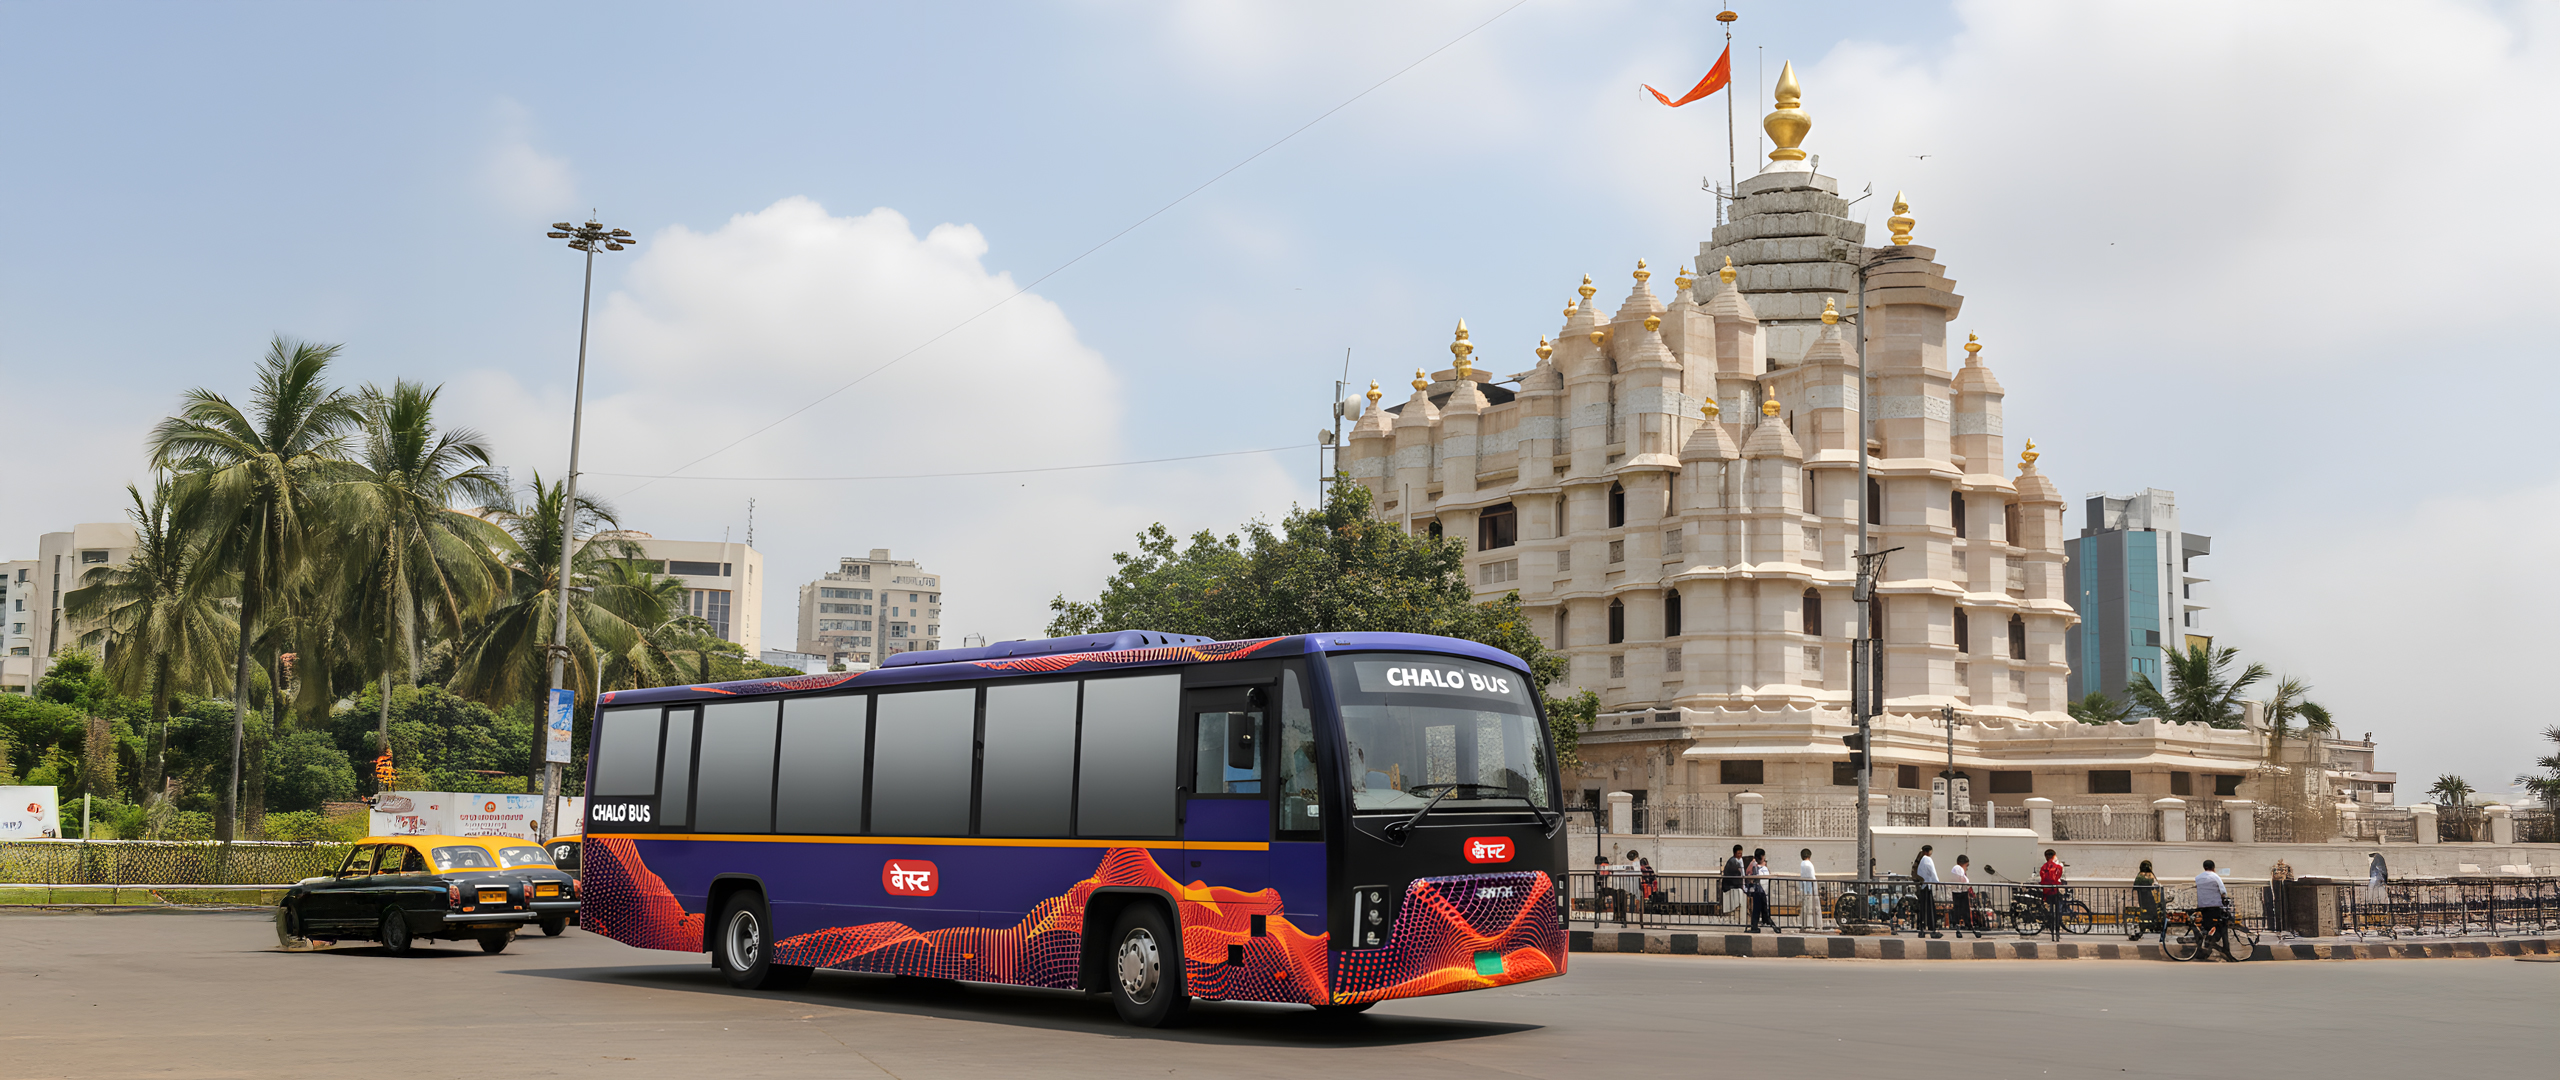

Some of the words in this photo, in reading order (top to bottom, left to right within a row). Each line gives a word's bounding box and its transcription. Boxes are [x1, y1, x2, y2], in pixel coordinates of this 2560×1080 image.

[1468, 672, 1510, 694] BUS
[628, 804, 651, 823] BUS
[890, 862, 931, 892] बेस्ट
